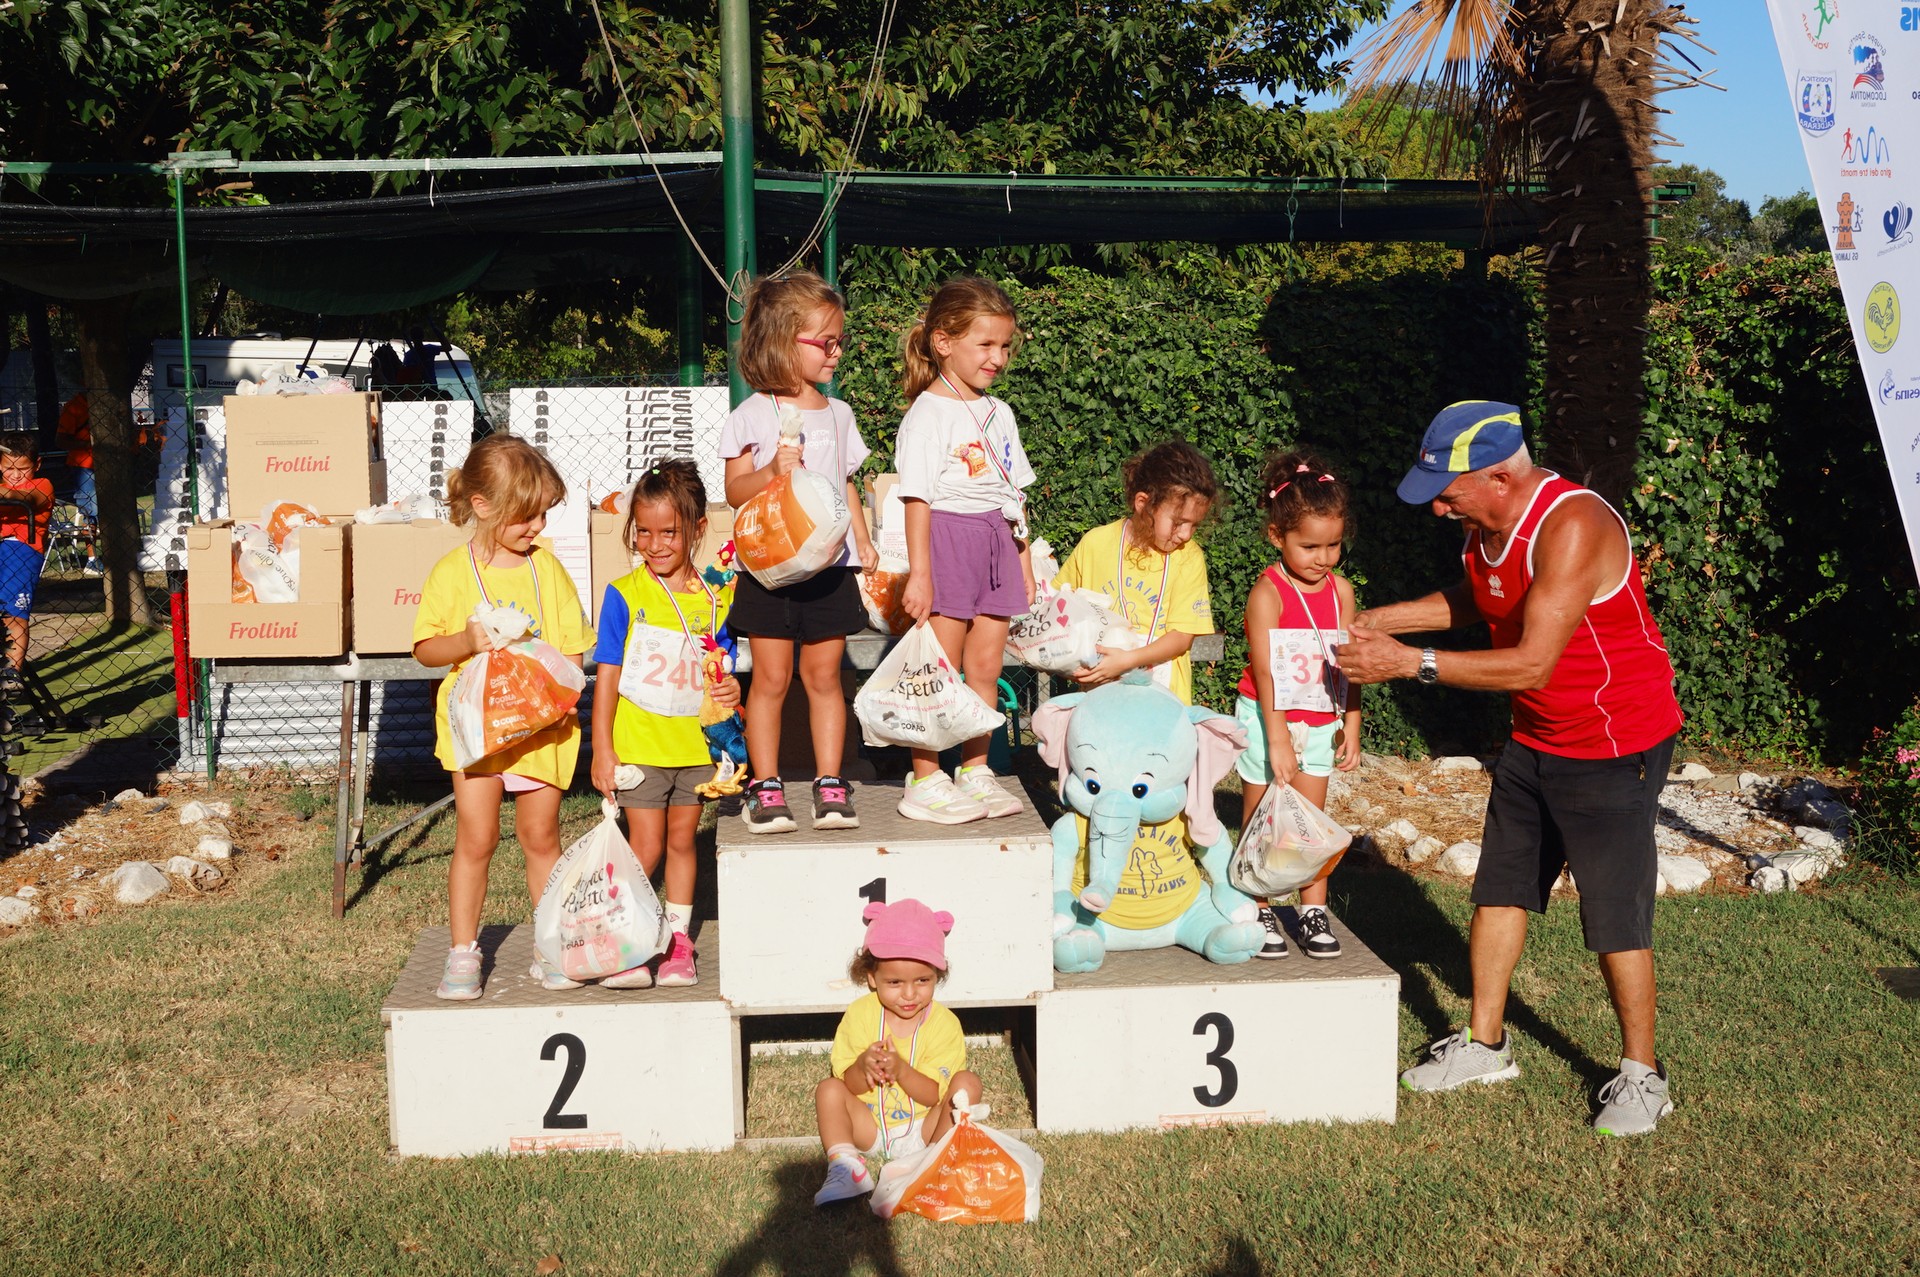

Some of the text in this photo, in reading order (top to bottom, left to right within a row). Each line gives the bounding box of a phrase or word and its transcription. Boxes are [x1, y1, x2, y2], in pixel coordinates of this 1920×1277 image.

[265, 456, 331, 472] Frollini
[394, 588, 422, 605] Fro
[229, 622, 299, 639] Frollini
[642, 653, 704, 692] 240
[1192, 1012, 1239, 1108] 3
[540, 1032, 588, 1129] 2
